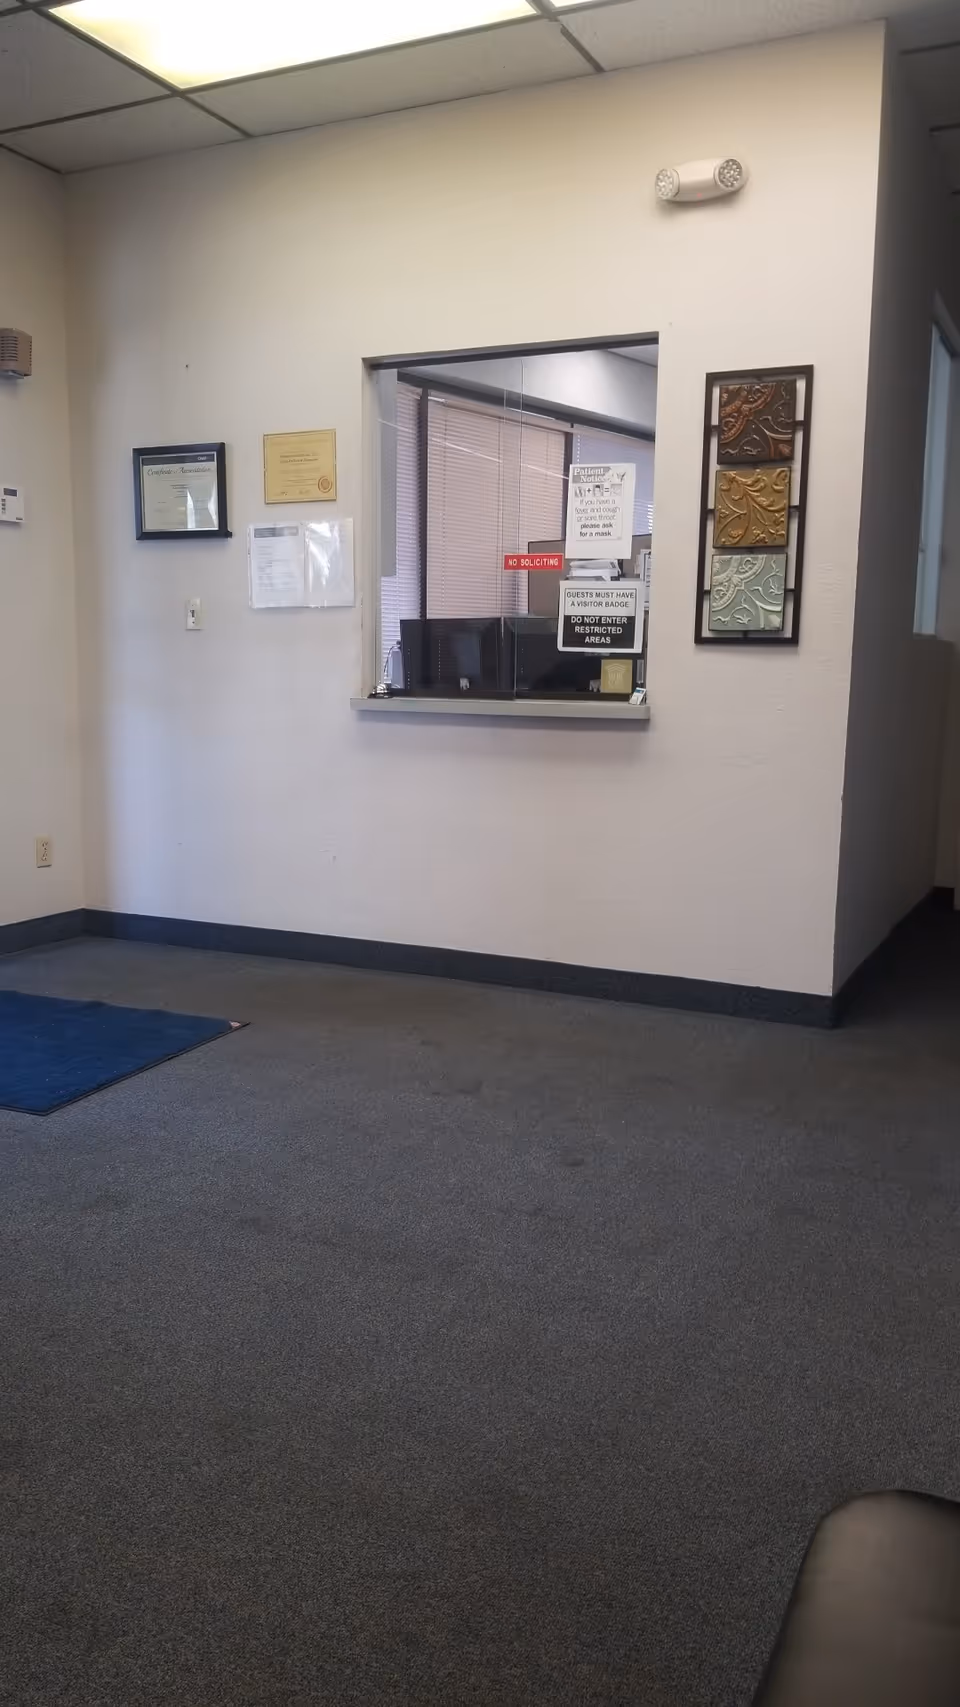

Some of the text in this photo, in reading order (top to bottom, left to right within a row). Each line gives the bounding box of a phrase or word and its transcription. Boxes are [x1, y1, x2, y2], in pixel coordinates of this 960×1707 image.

[574, 467, 604, 476] Patient
[602, 507, 620, 515] cough
[520, 558, 559, 566] SOLICITING
[584, 616, 600, 624] NOT
[574, 626, 623, 634] RESTRICTED
[585, 636, 611, 644] AREAS
